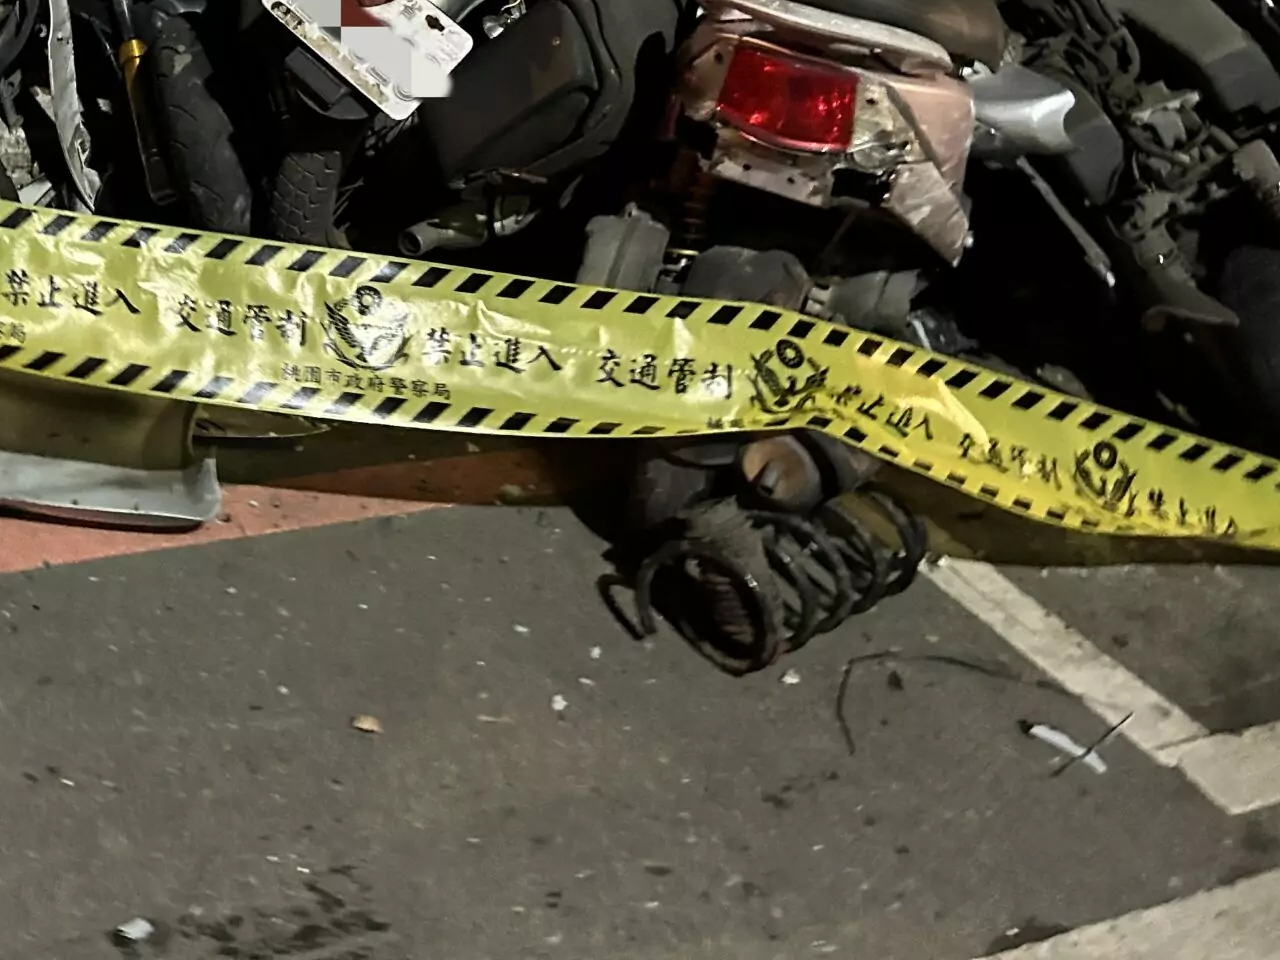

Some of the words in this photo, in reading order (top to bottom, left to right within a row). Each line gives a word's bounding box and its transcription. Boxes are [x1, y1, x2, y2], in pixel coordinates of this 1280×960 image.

[1, 268, 141, 315] 禁止進入
[173, 293, 308, 347] 交通管制
[421, 327, 562, 373] 禁止進入
[596, 348, 734, 399] 交通管制
[280, 362, 452, 401] 桃園市政府警察局
